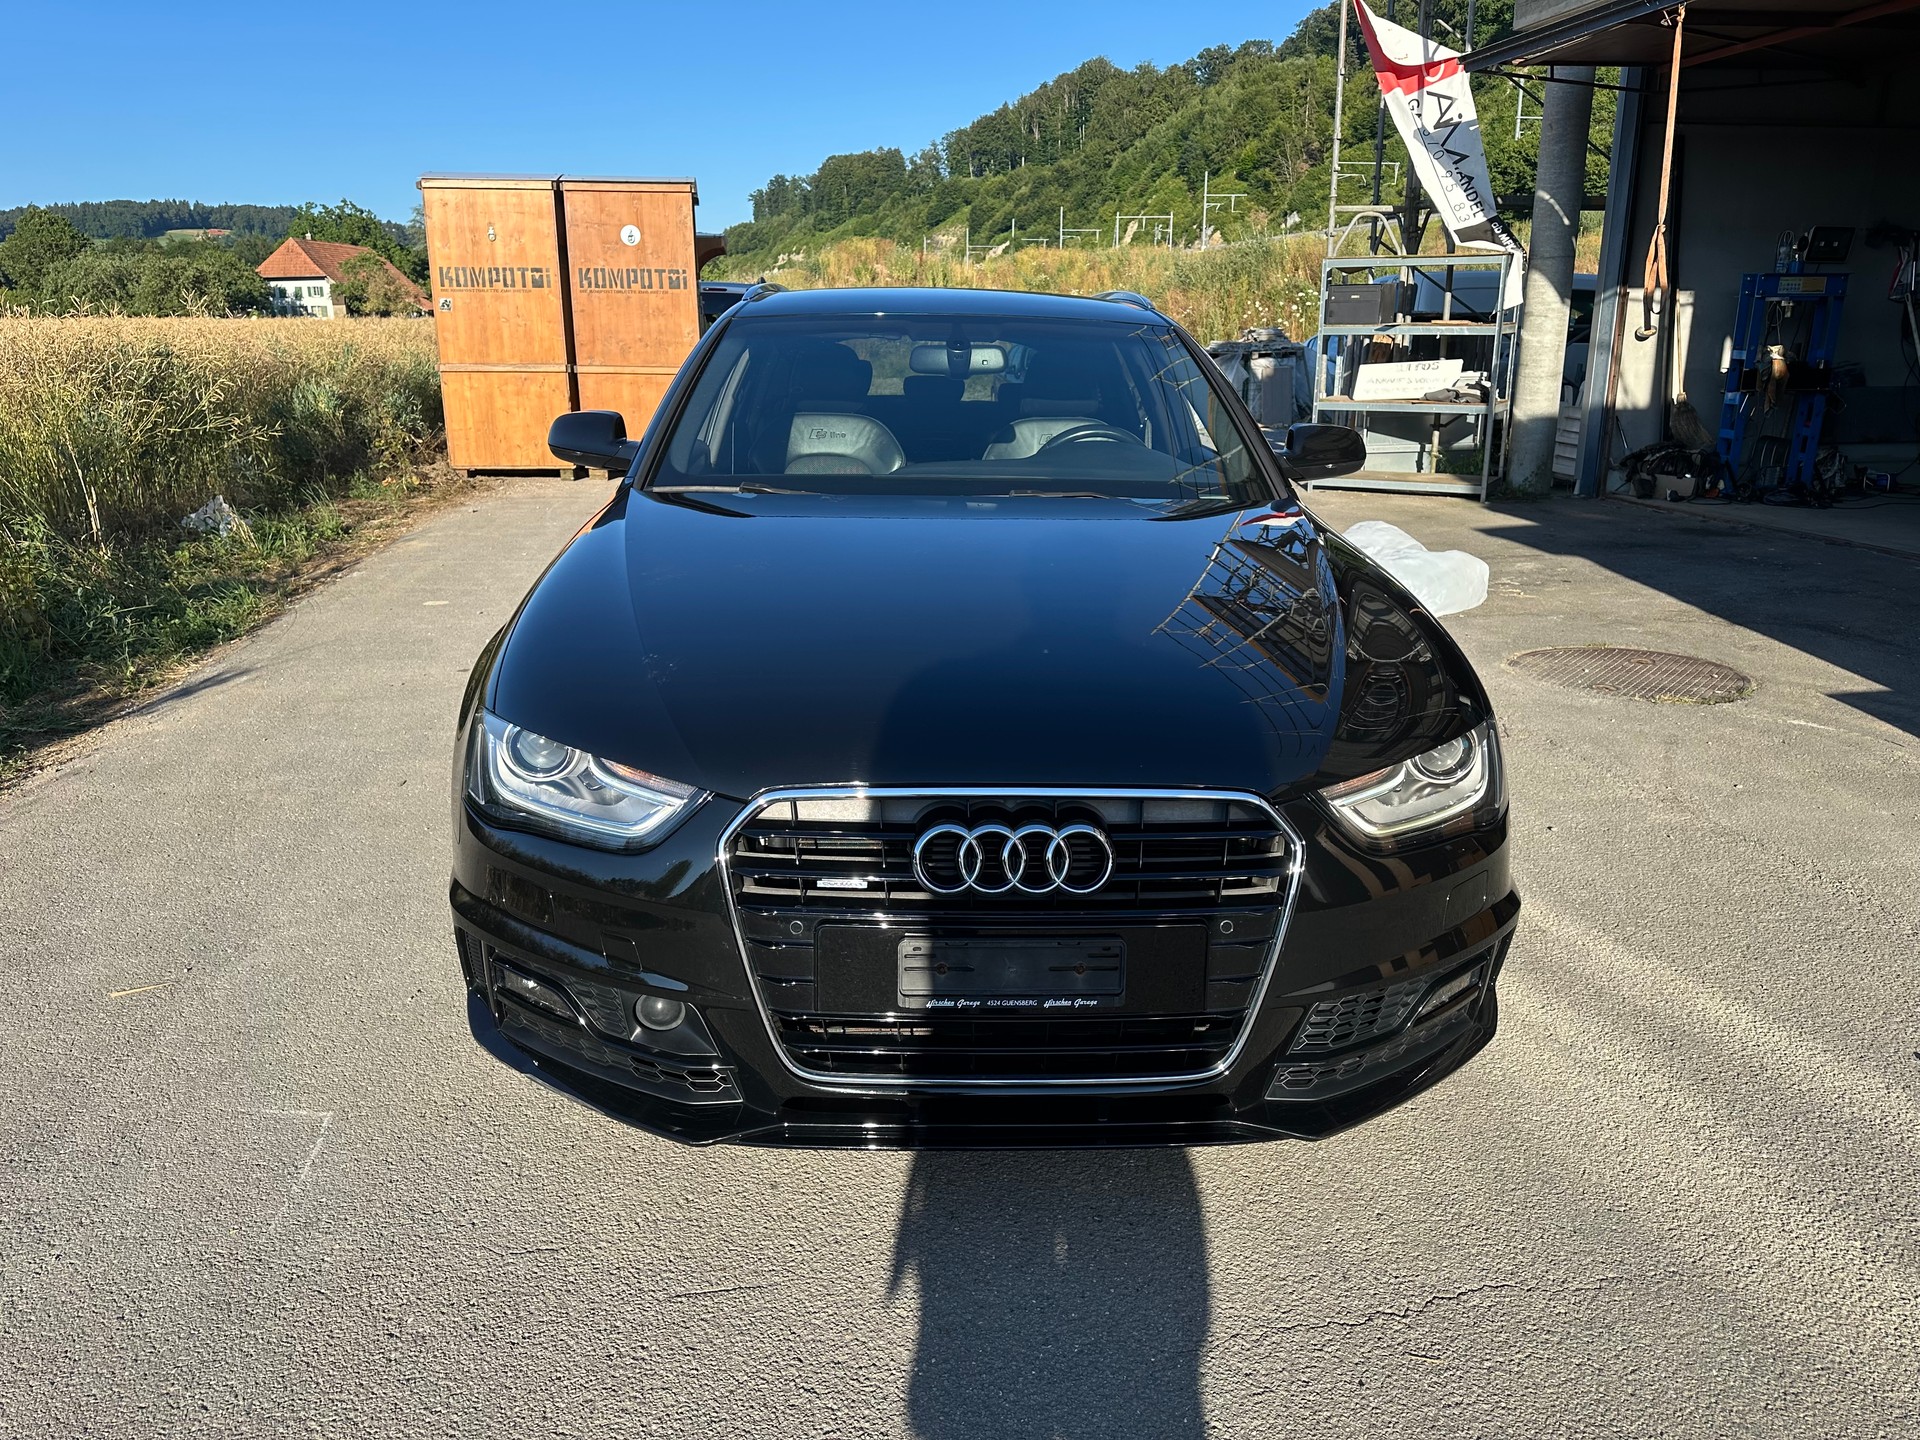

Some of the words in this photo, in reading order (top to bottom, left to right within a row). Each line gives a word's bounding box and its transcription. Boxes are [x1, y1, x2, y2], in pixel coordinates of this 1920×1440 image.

[1455, 167, 1484, 218] ANDEL
[1491, 222, 1503, 234] ab
[926, 998, 955, 1009] Hirschen
[957, 999, 981, 1009] Garage
[1043, 998, 1072, 1009] Hirschen
[1073, 998, 1098, 1009] Garage
